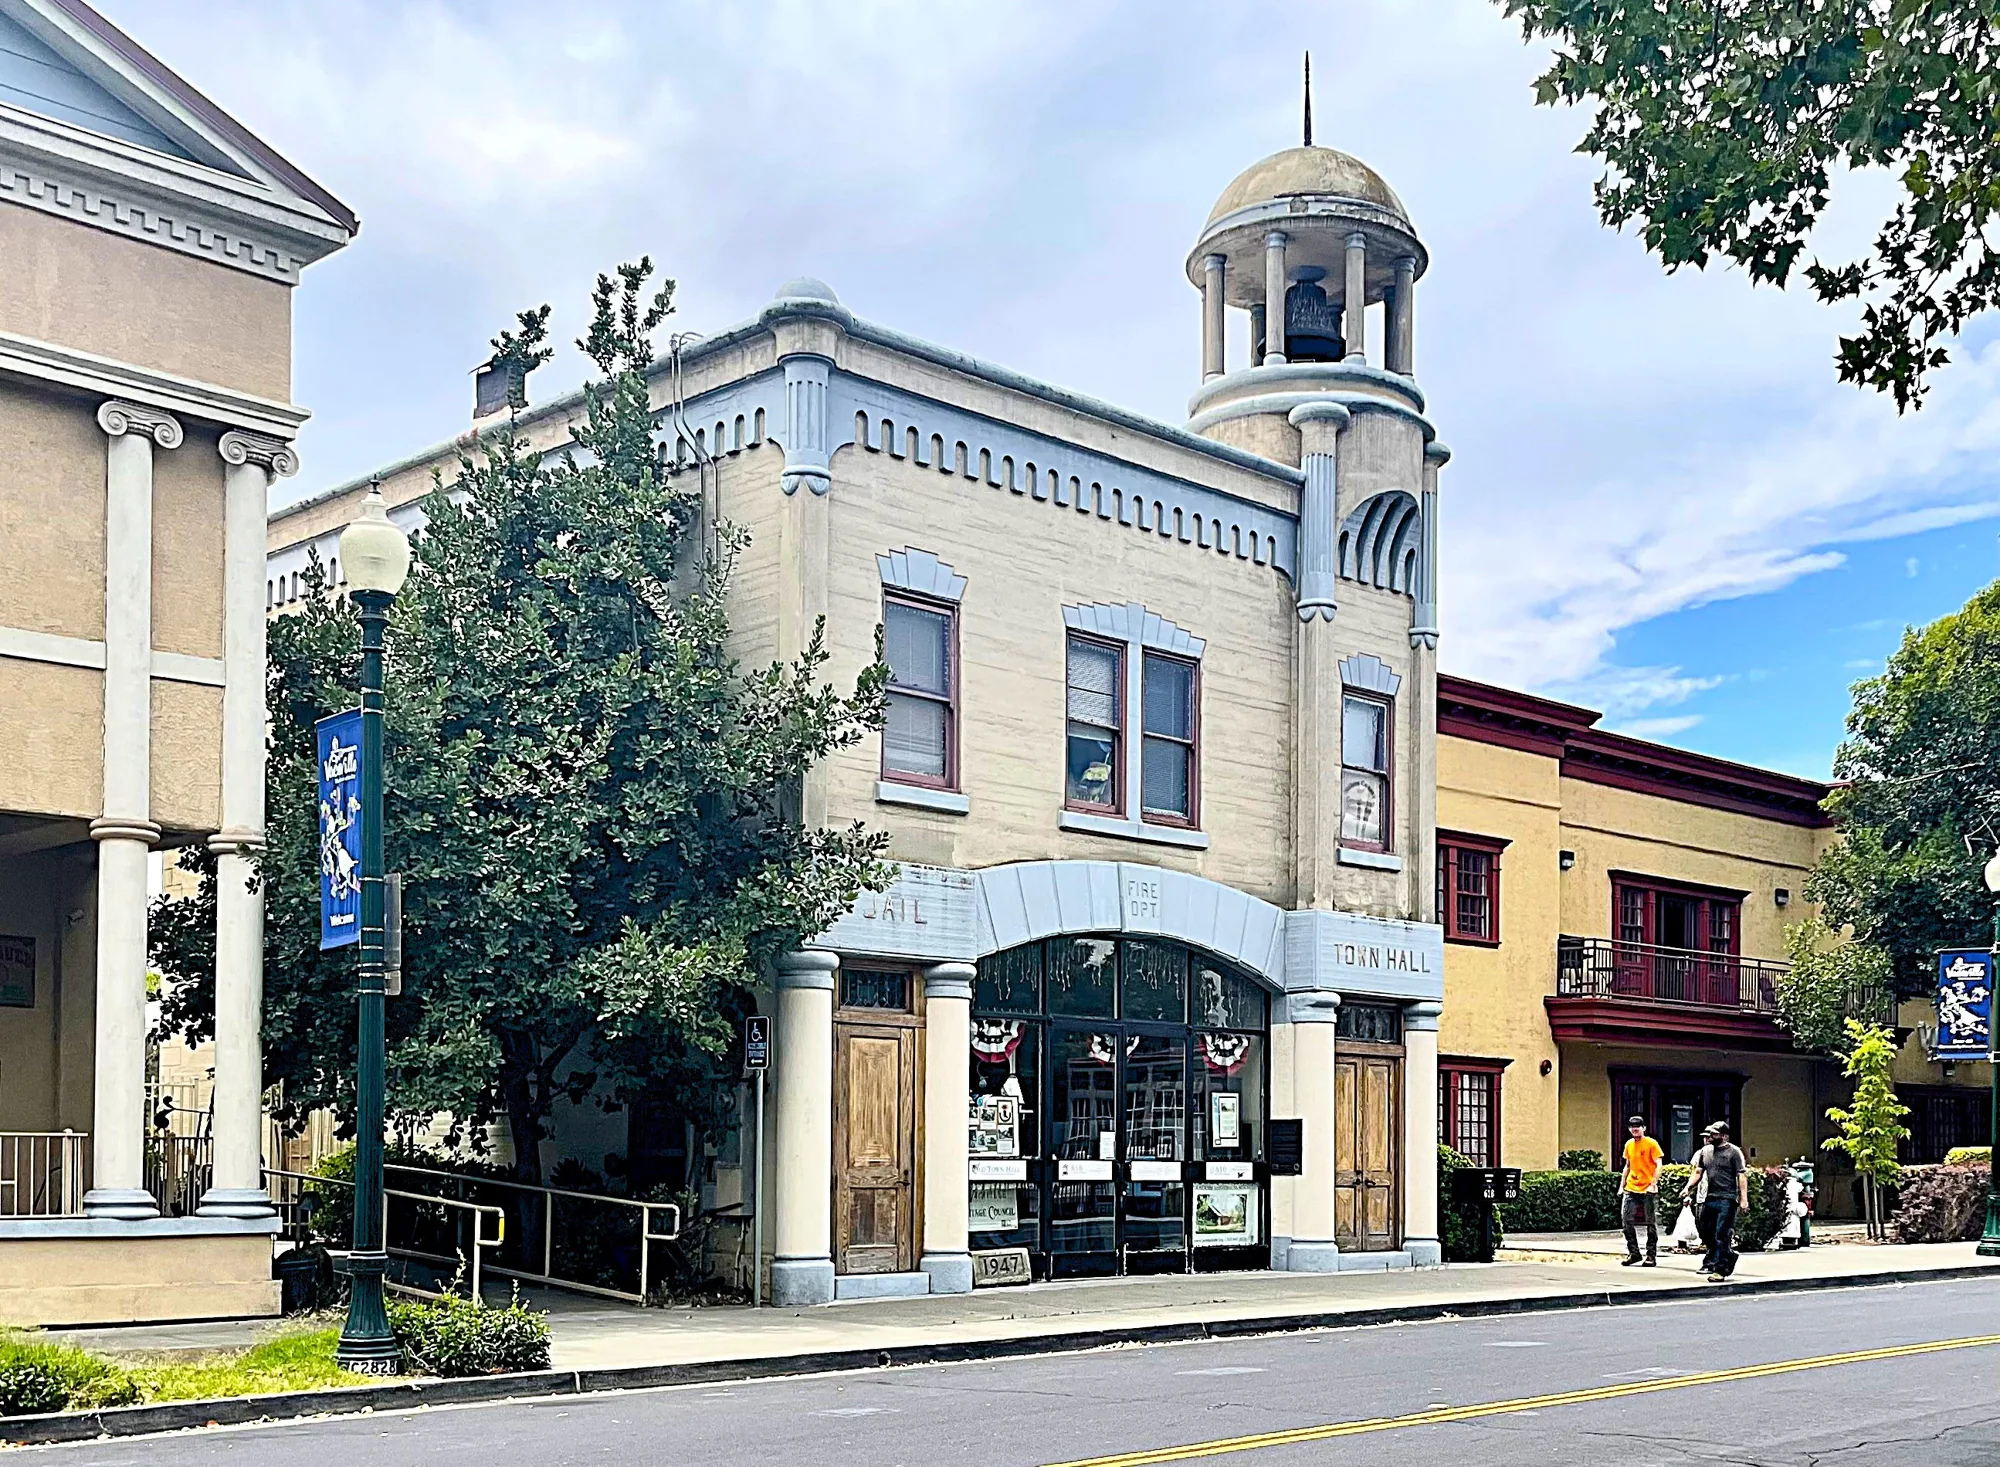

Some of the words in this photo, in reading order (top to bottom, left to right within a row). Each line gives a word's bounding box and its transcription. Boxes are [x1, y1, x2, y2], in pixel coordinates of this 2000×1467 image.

[1128, 880, 1158, 899] FIRE
[862, 892, 928, 925] JAIL
[1334, 943, 1379, 968] TOWN
[1387, 947, 1431, 973] HALL
[983, 1256, 1019, 1275] 1947
